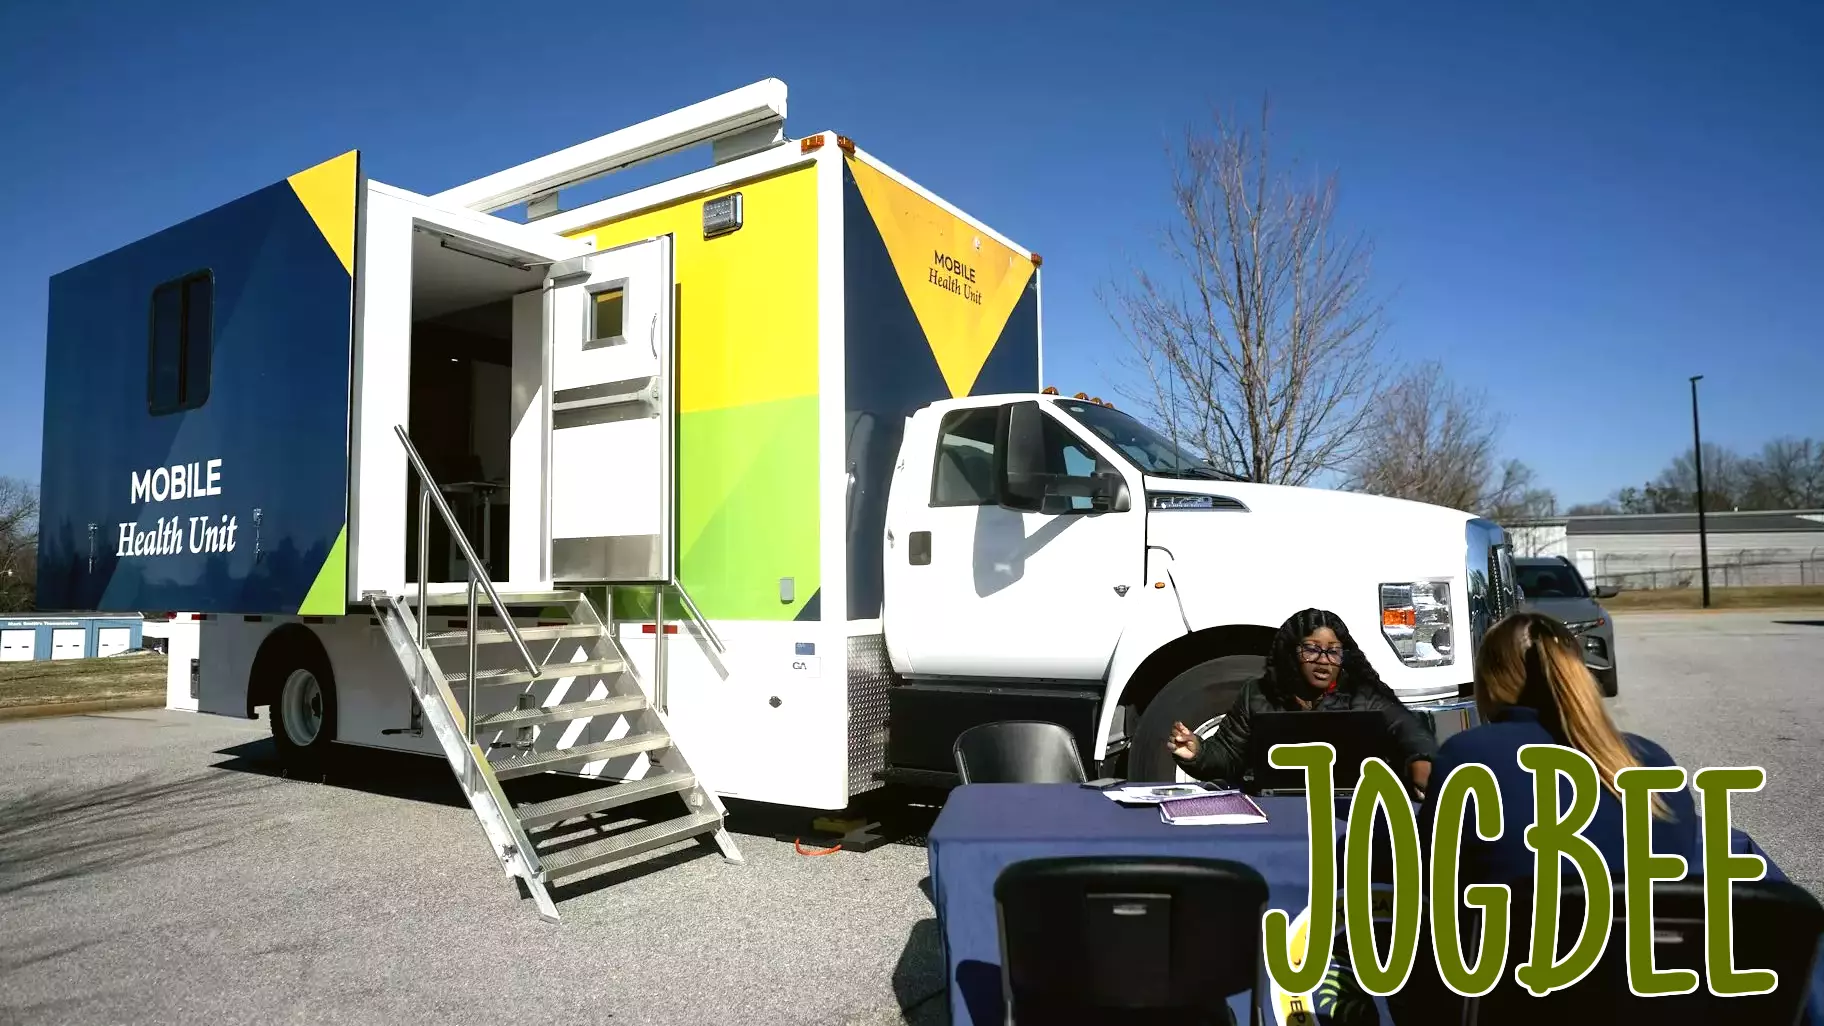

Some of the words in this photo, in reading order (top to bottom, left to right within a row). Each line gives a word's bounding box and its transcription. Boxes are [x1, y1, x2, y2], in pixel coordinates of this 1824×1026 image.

[928, 267, 961, 295] Health
[964, 283, 982, 305] Unit
[934, 250, 976, 283] MOBILE
[131, 458, 222, 504] MOBILE
[116, 516, 184, 557] Health
[188, 514, 238, 554] Unit
